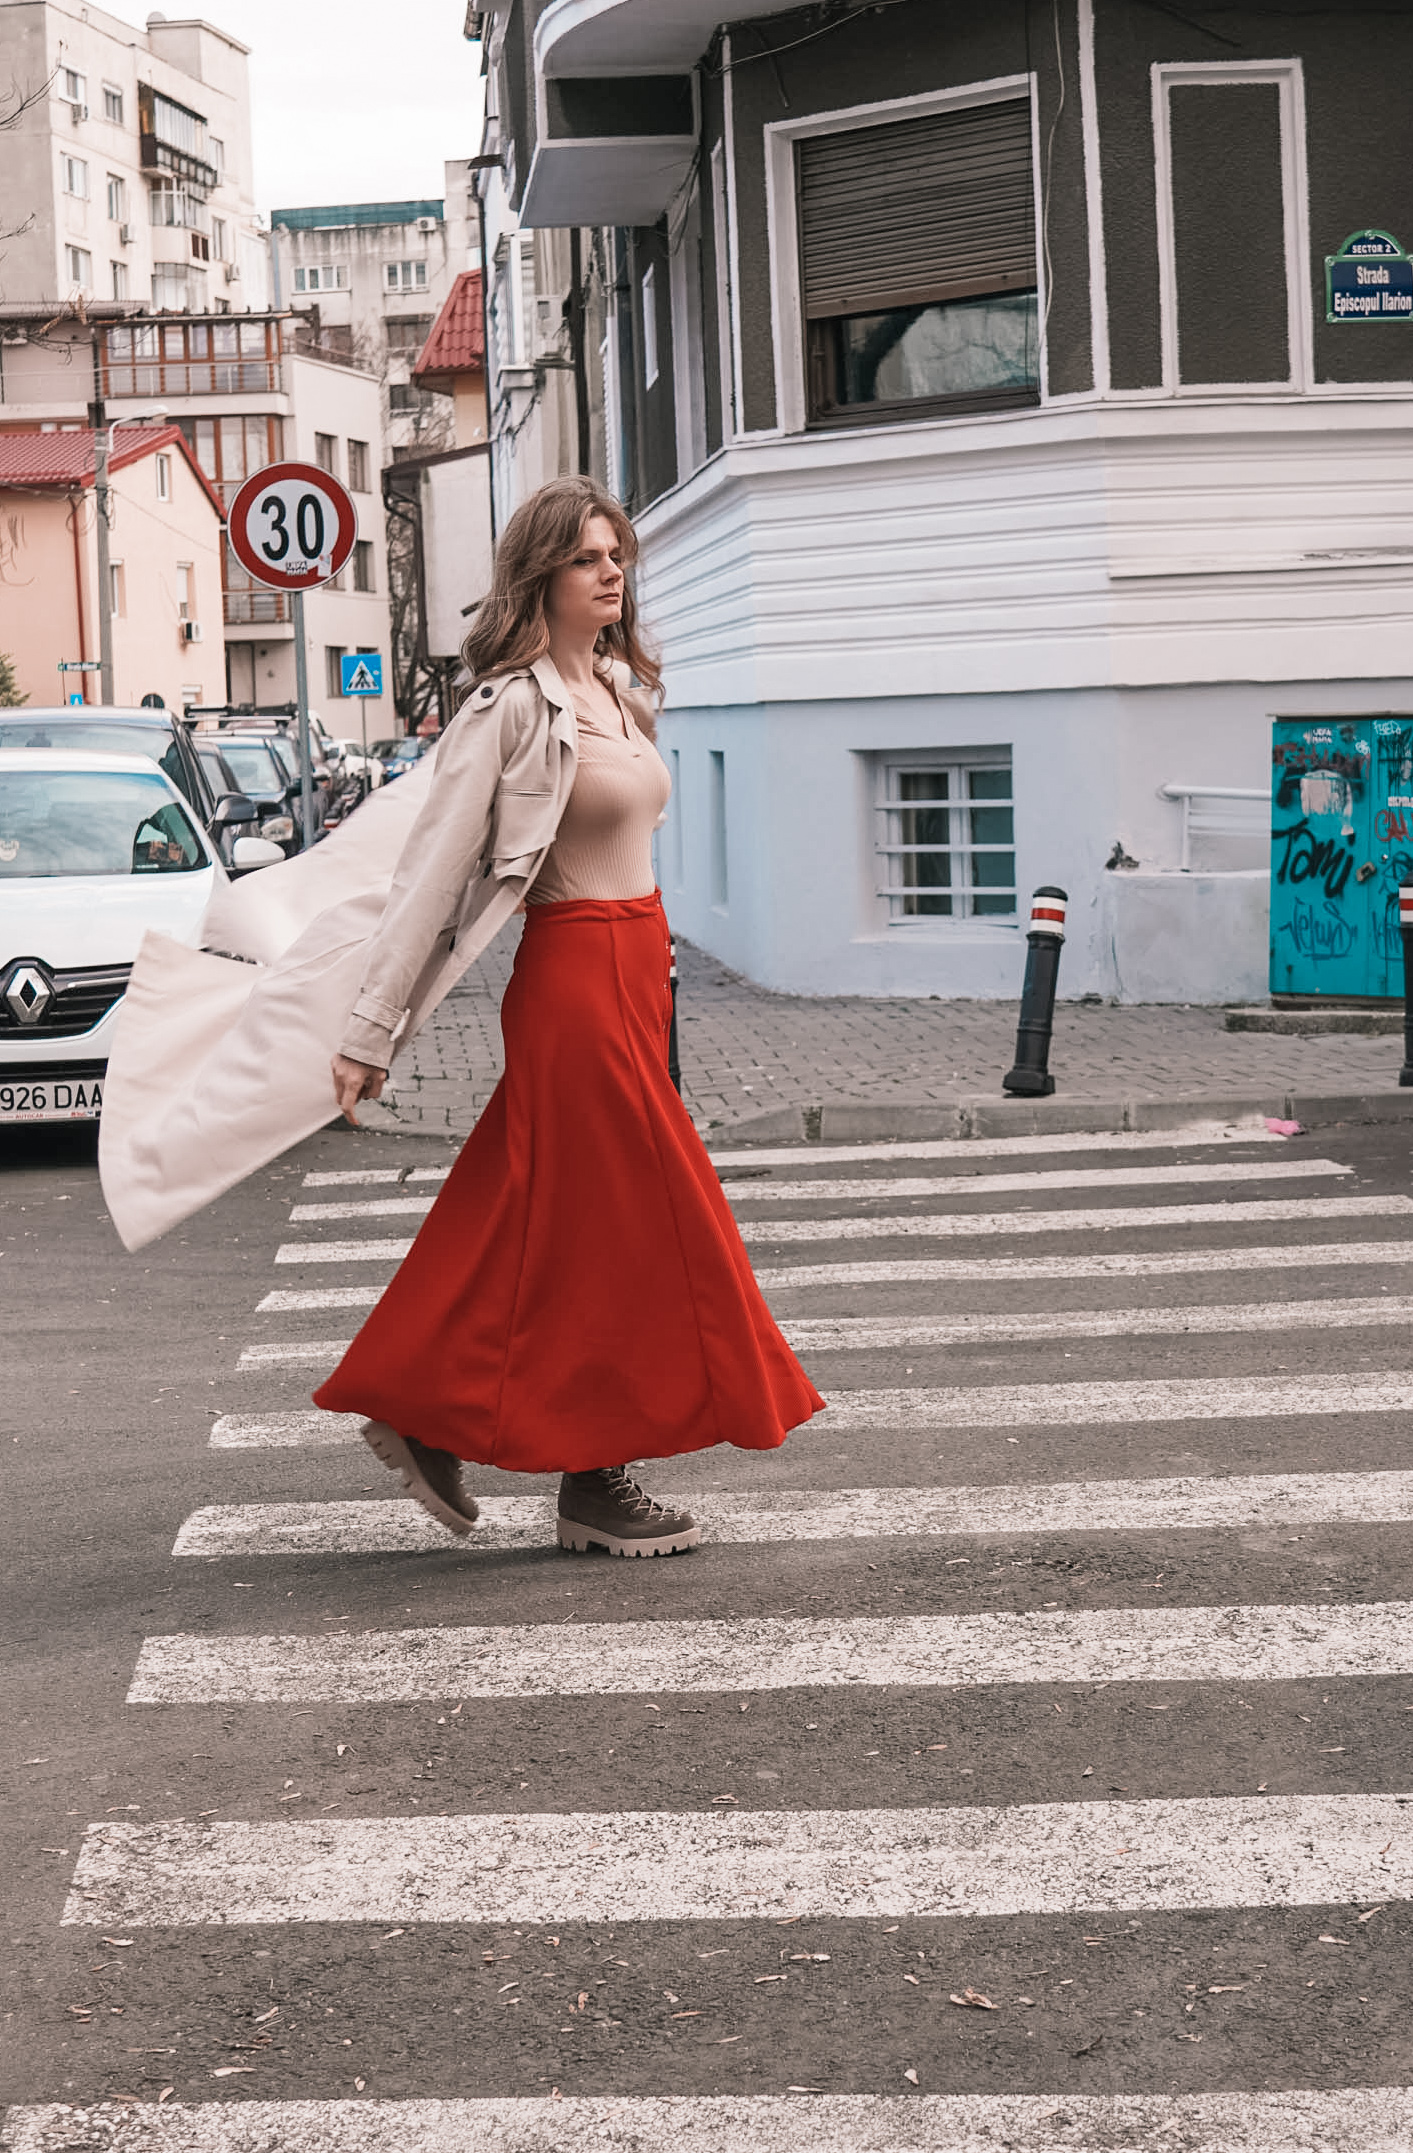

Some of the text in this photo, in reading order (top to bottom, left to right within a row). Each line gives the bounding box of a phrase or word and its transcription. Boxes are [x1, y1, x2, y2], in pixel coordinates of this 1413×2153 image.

[1352, 243, 1392, 254] SECTOR 2
[1356, 265, 1390, 285] Strada
[1334, 290, 1413, 317] Episcopul Ilarion
[261, 494, 325, 562] 30
[0, 1083, 103, 1112] 926 DAA
